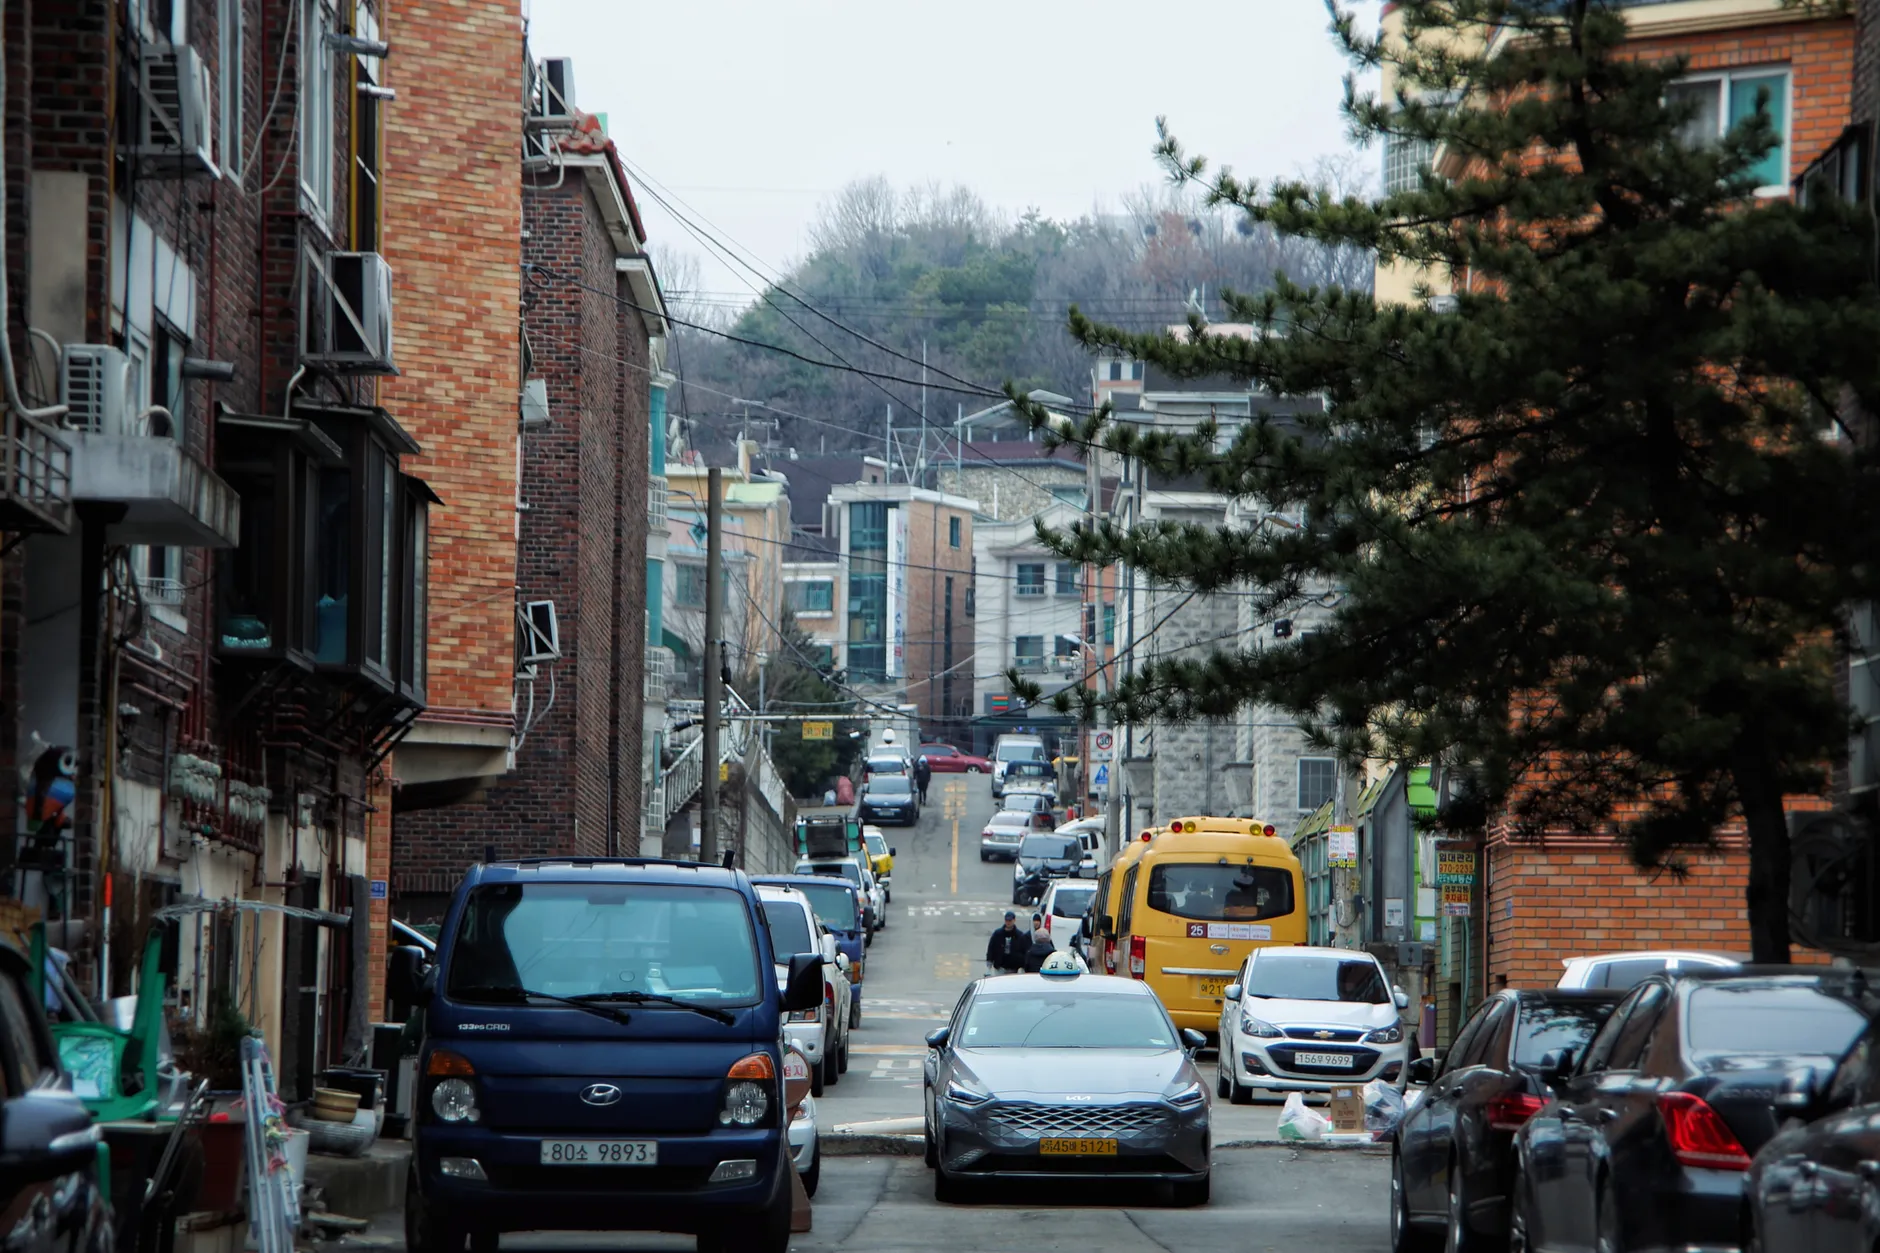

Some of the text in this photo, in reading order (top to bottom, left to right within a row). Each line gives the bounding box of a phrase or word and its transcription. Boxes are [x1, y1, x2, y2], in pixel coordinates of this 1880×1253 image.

[1190, 925, 1203, 936] 25
[1325, 1055, 1350, 1065] 9699
[551, 1143, 647, 1161] 80소 9893
[1080, 1140, 1112, 1153] 5121
